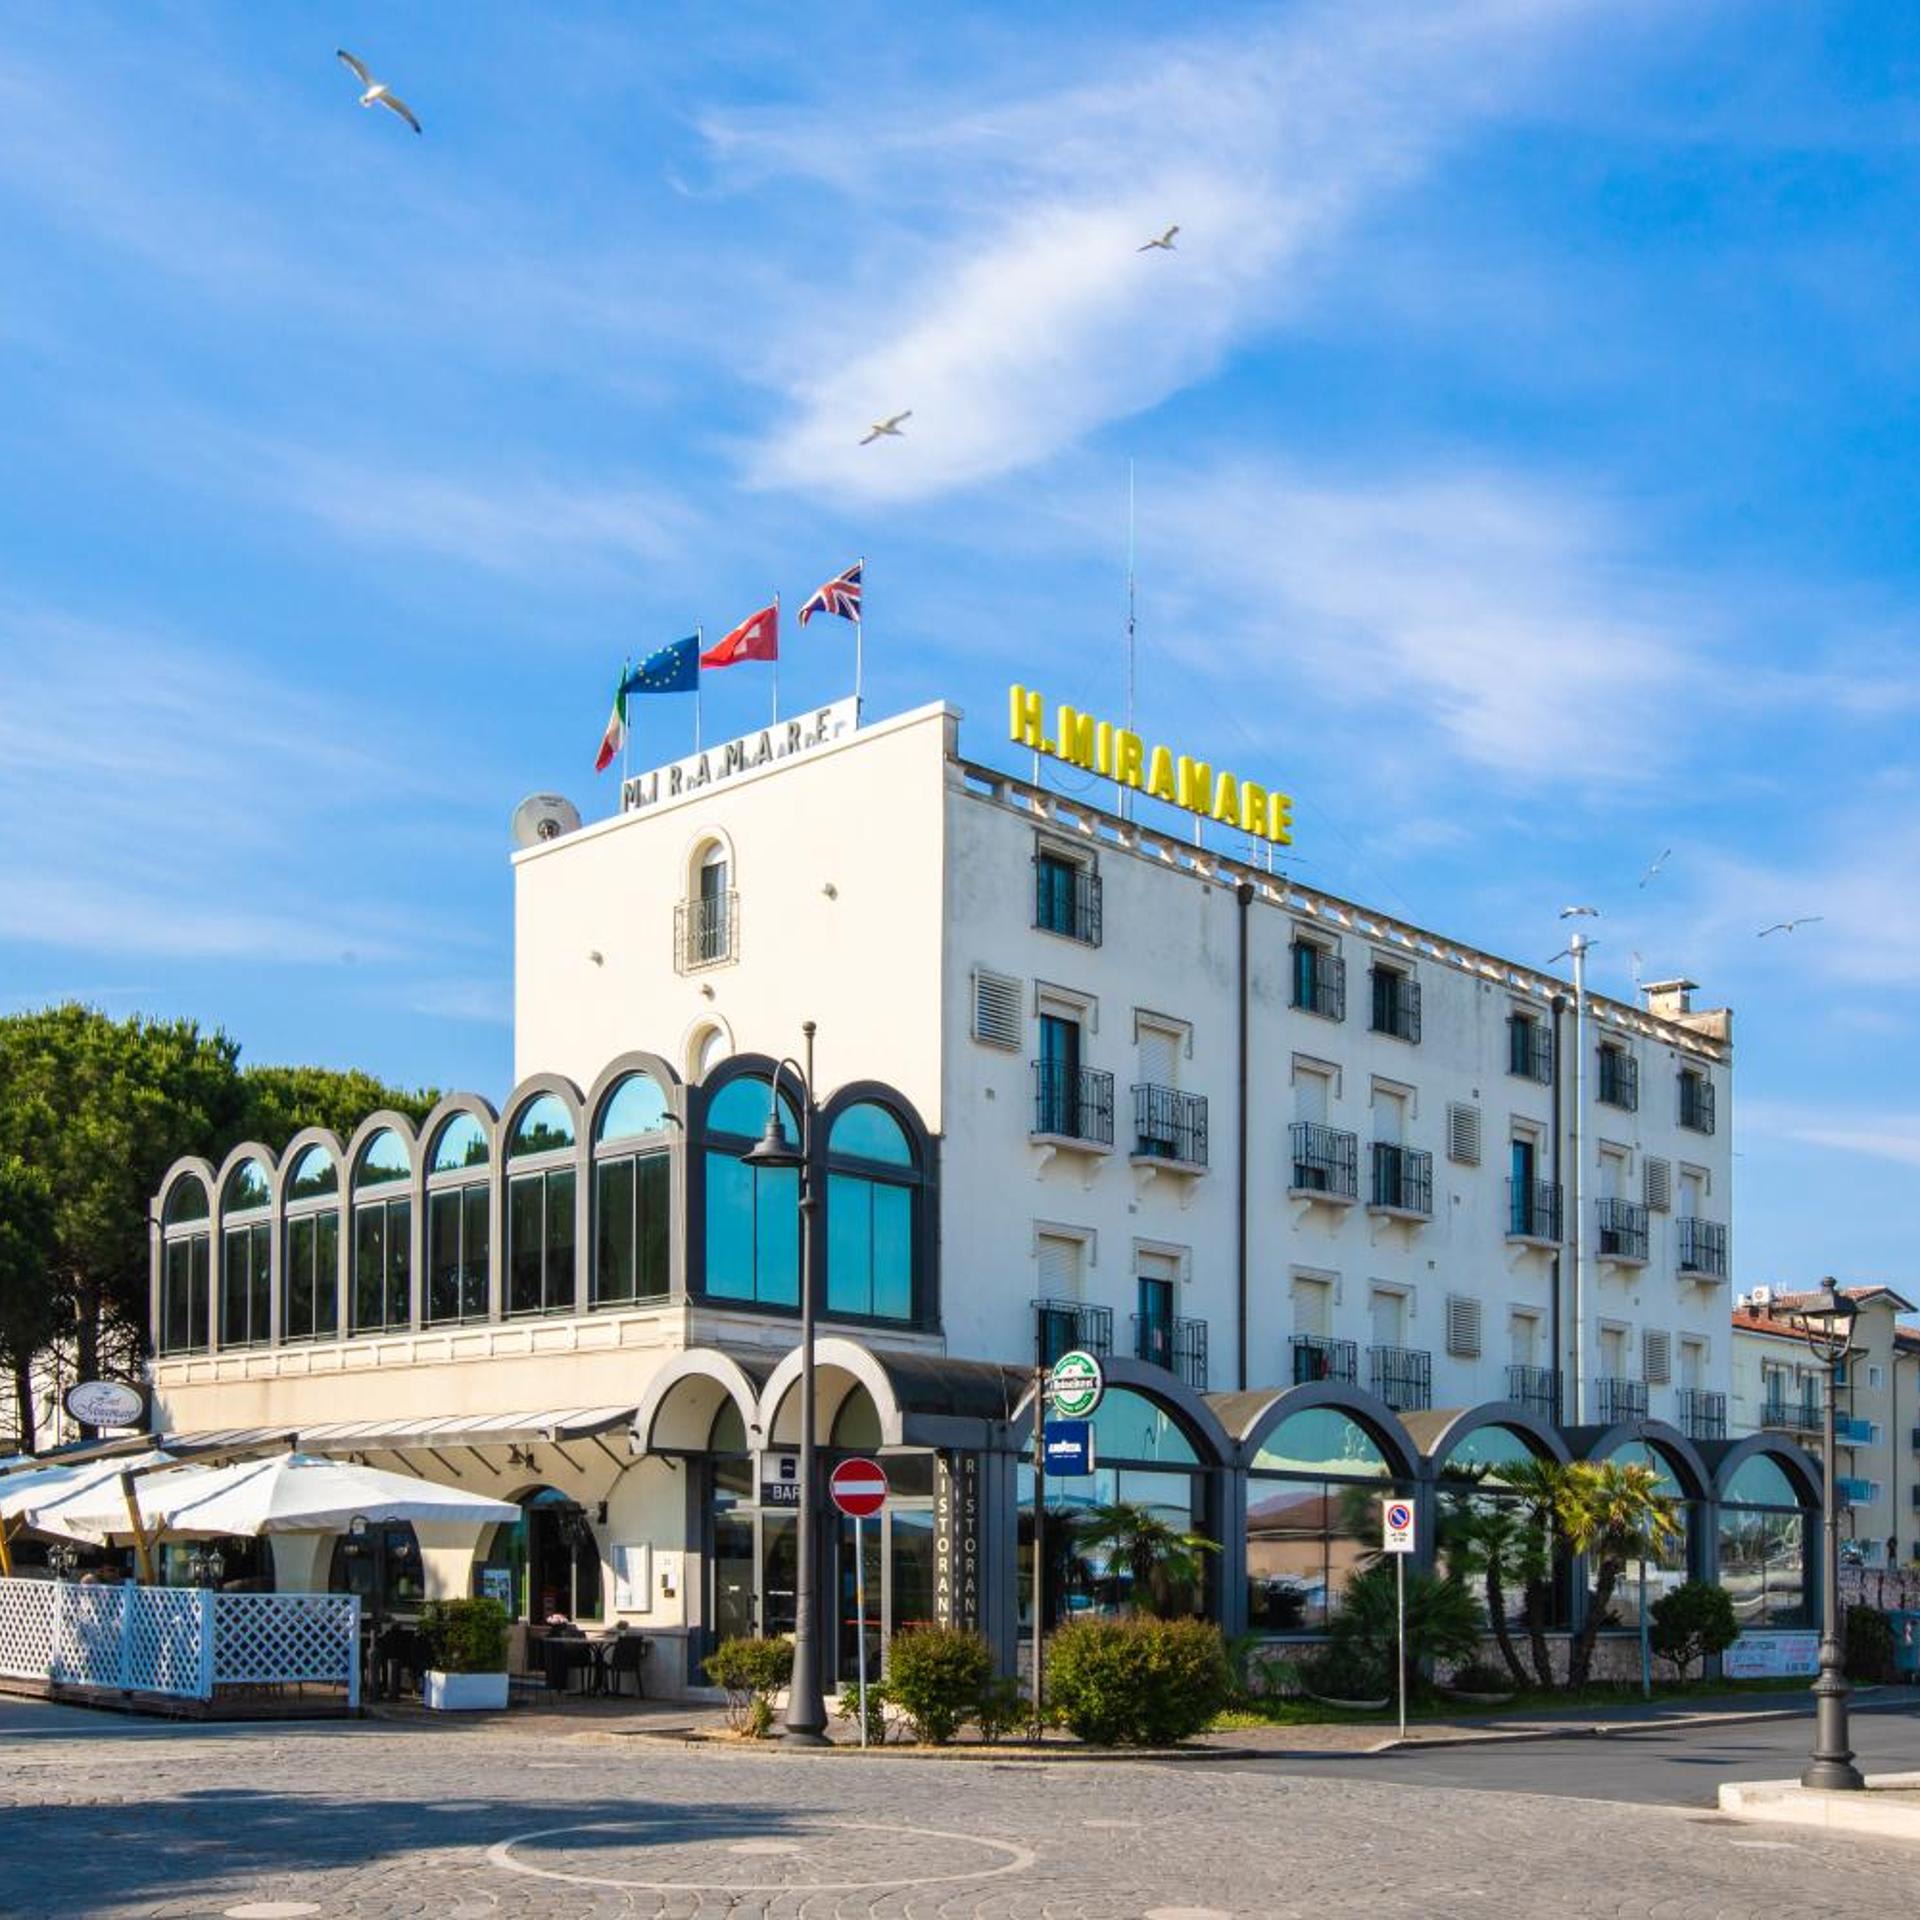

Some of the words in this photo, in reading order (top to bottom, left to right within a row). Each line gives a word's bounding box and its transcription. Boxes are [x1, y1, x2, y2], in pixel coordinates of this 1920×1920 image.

[623, 709, 831, 813] MIRAMARE
[937, 1458, 950, 1632] RISTORANT
[964, 1458, 977, 1632] RISTORANT
